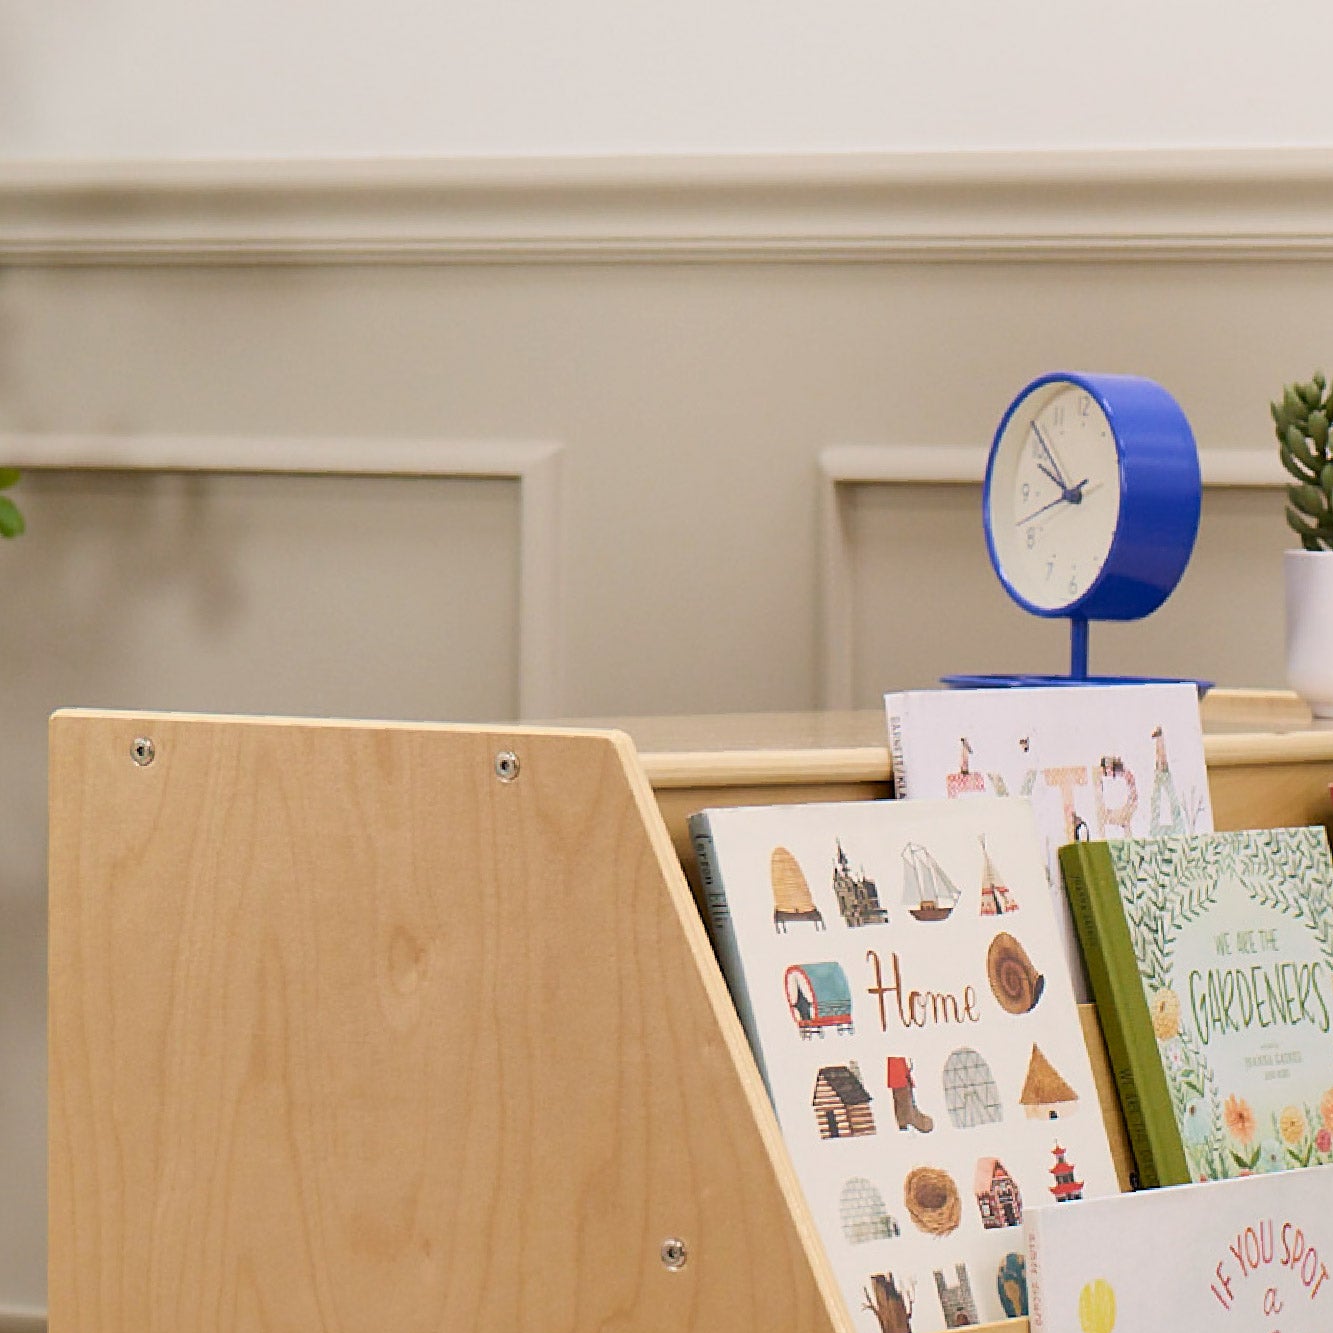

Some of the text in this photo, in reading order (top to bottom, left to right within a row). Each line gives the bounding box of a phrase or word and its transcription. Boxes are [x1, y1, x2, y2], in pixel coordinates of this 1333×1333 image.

[1022, 482, 1031, 504] 9
[1026, 526, 1036, 550] 8
[1068, 573, 1078, 596] 6
[1215, 932, 1232, 956] WE
[1258, 928, 1280, 952] THE
[866, 951, 981, 1032] Home
[1189, 962, 1330, 1045] GARDENERS
[1210, 1218, 1331, 1311] IF YOU SPOT
[1263, 1288, 1283, 1316] a
